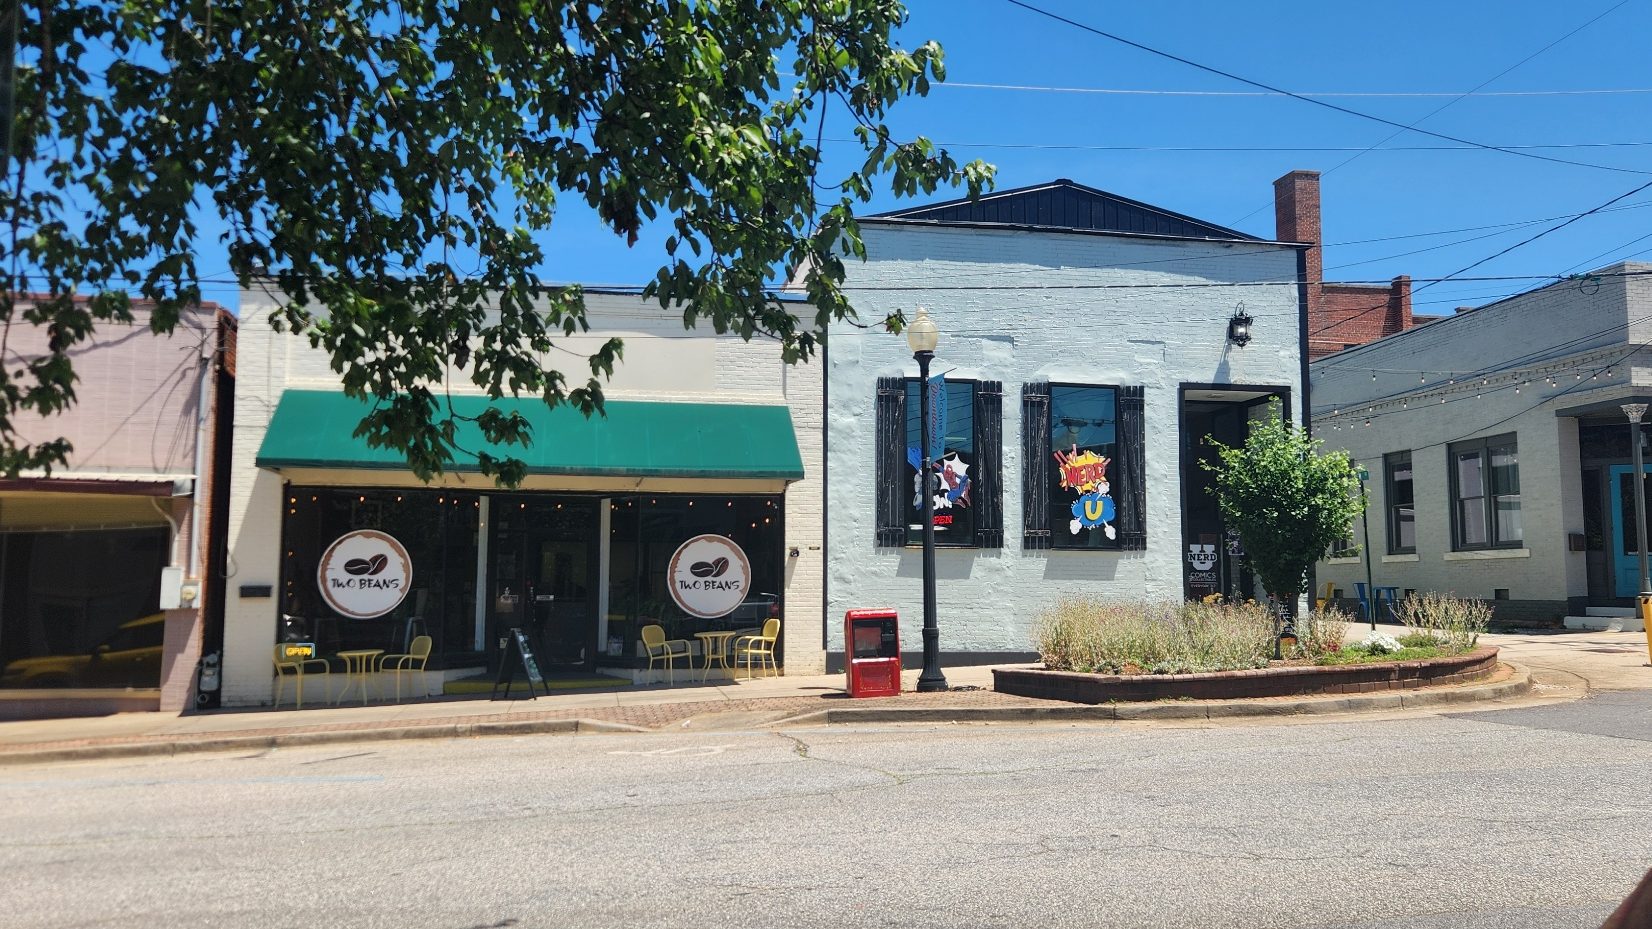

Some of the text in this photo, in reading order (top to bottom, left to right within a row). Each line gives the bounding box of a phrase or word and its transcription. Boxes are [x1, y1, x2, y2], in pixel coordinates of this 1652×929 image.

[1066, 463, 1105, 486] NERD
[1084, 500, 1103, 520] U
[1189, 553, 1216, 561] NERD
[331, 578, 399, 590] TWO BEANS
[679, 580, 740, 592] TWO BEANS
[286, 647, 312, 657] OPEN
